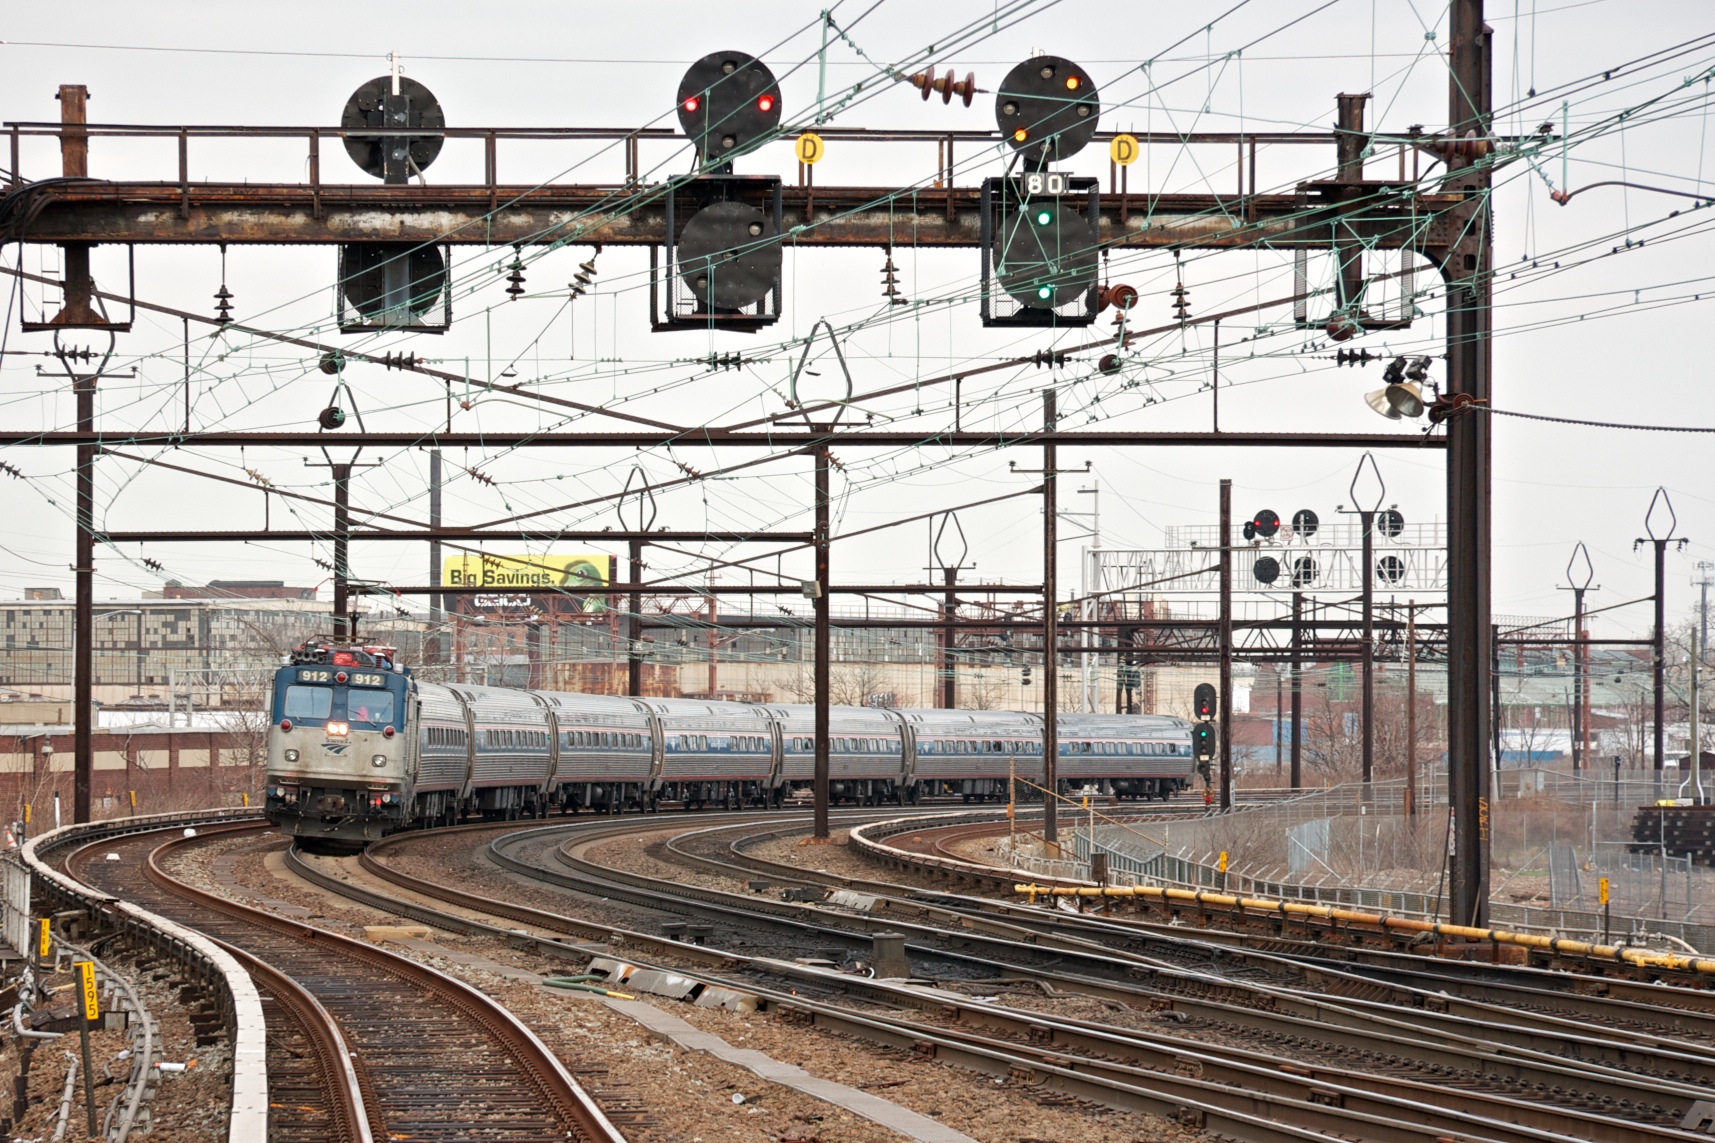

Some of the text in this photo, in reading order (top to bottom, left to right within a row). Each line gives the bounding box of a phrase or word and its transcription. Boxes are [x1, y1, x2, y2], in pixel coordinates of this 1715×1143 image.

[802, 138, 817, 159] D
[1117, 140, 1132, 161] D
[1027, 175, 1063, 194] 80
[450, 569, 556, 587] Big Savings.
[302, 671, 328, 682] 912
[354, 673, 381, 686] 912
[86, 964, 97, 1017] 1595
